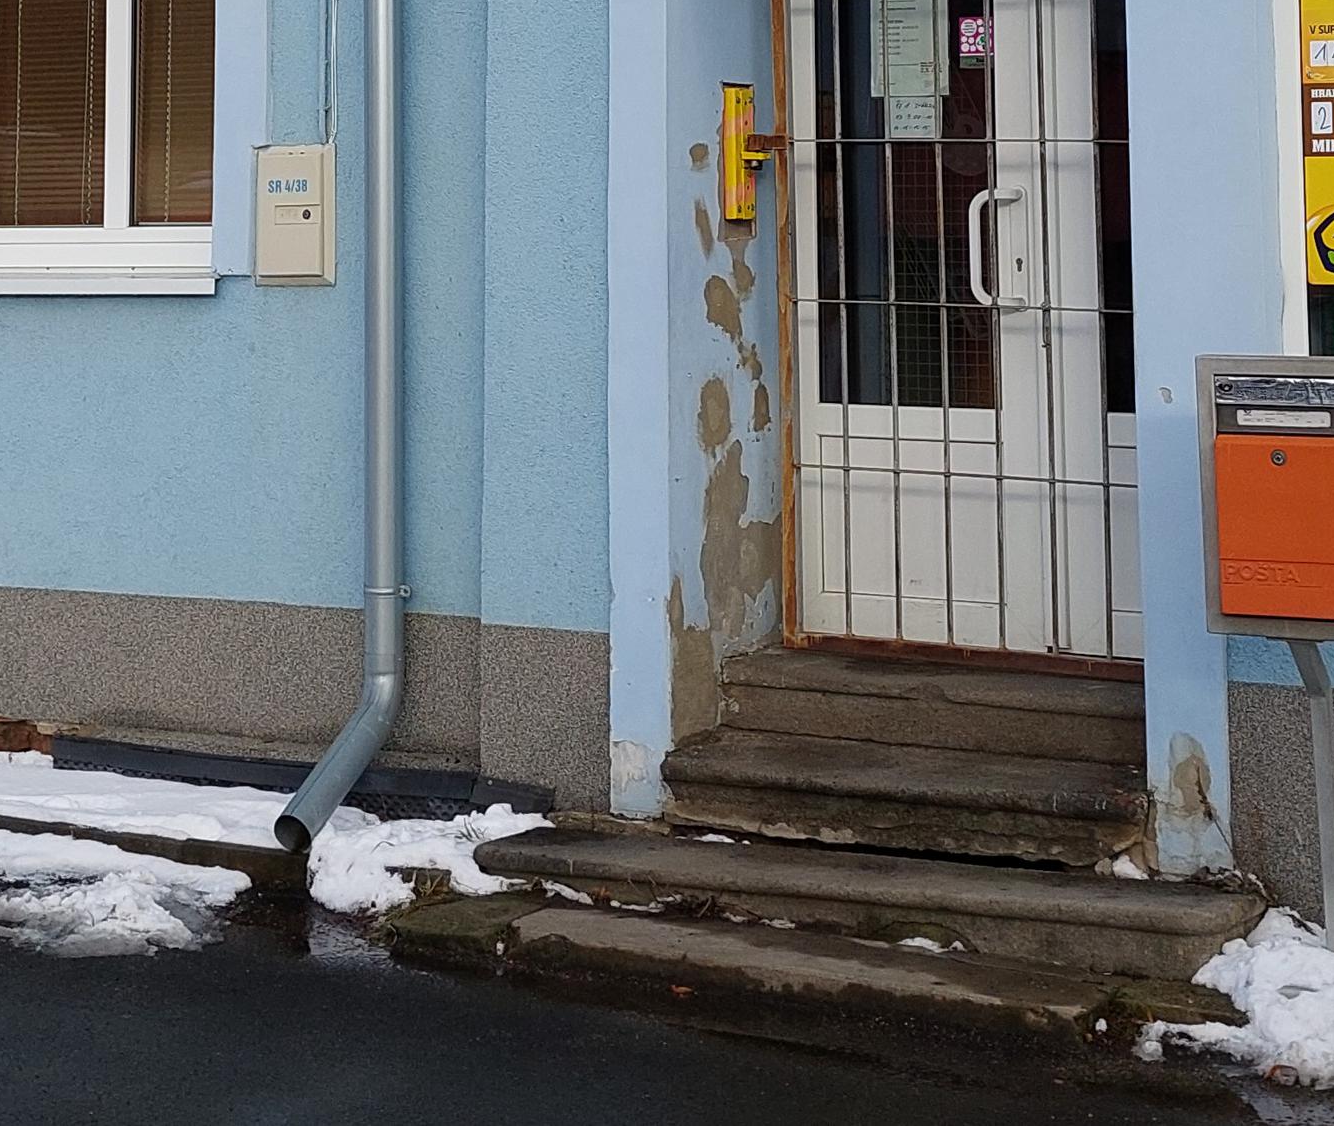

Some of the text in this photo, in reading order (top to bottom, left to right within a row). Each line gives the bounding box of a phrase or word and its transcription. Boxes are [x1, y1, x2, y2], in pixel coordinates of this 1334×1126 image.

[1309, 24, 1317, 35] V
[267, 179, 308, 193] SR 4/38
